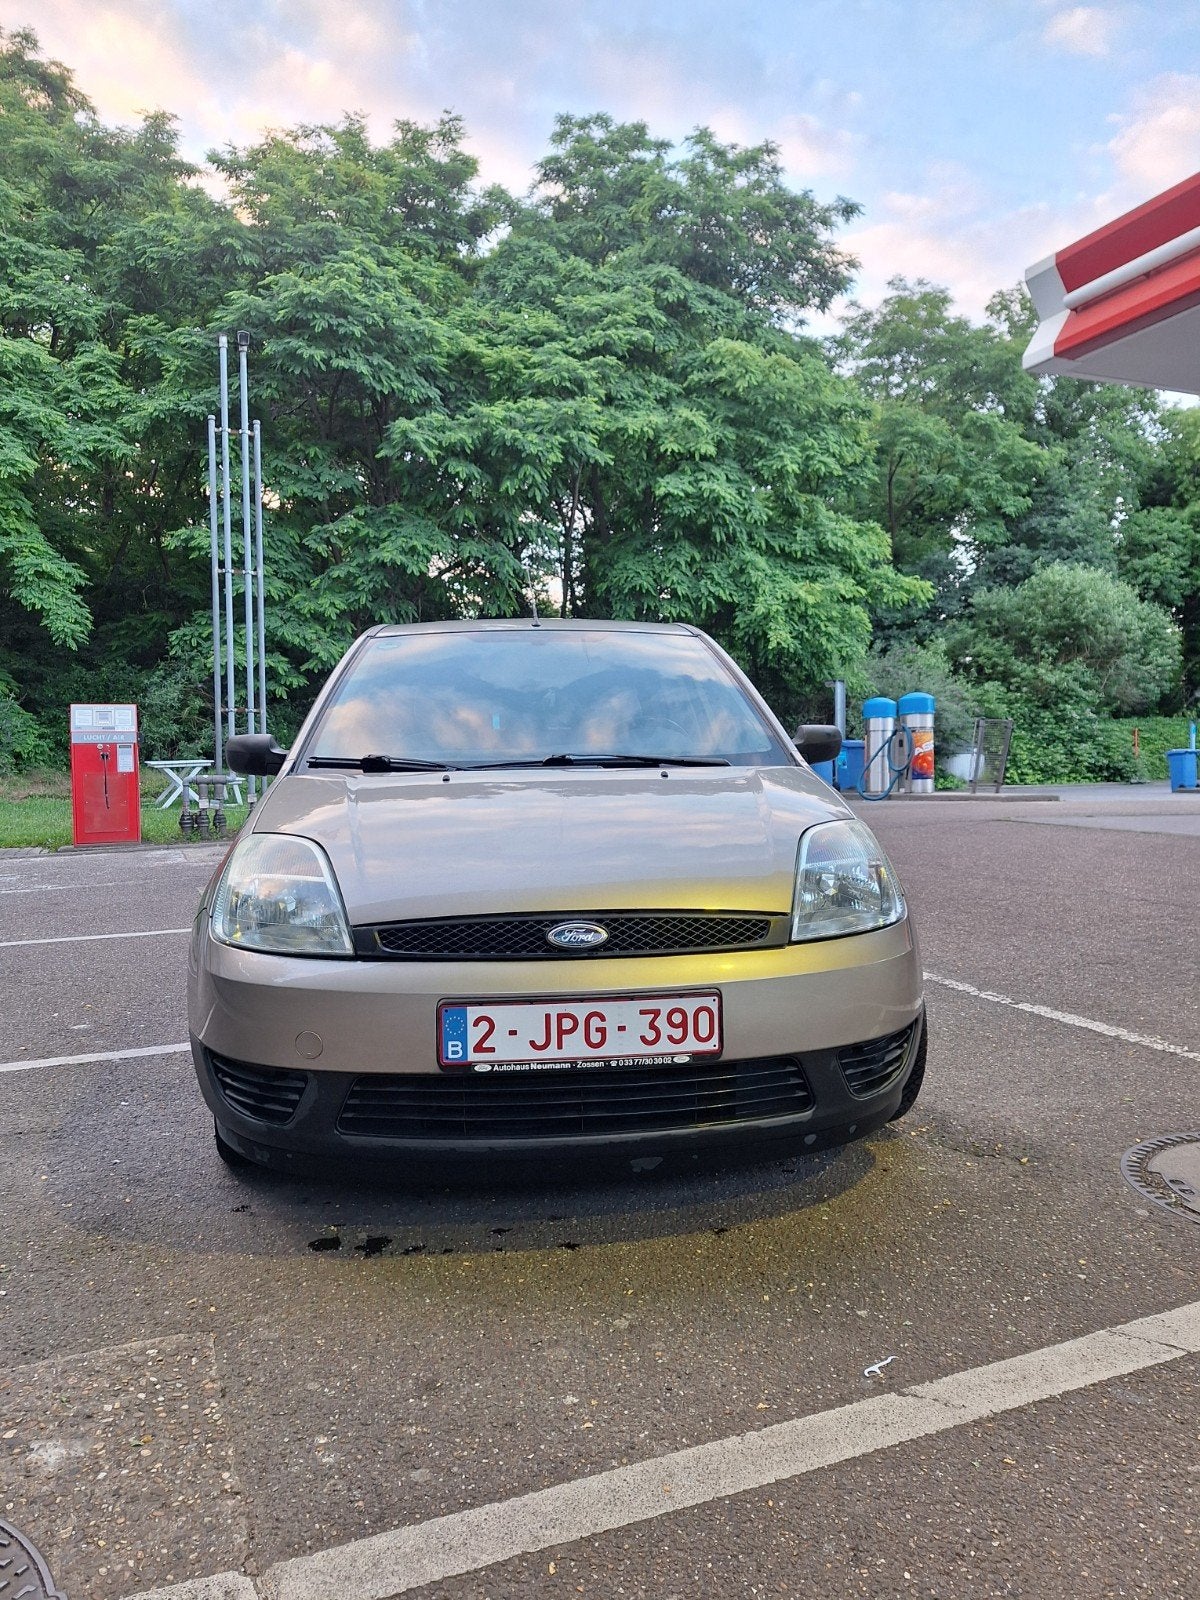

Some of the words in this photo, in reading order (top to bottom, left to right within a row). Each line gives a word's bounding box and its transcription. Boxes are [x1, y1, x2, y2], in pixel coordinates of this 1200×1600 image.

[562, 929, 594, 942] Ford
[447, 1041, 463, 1058] B
[493, 1064, 530, 1072] Autohaus
[530, 1062, 571, 1070] Neumann
[577, 1060, 604, 1068] Zossen
